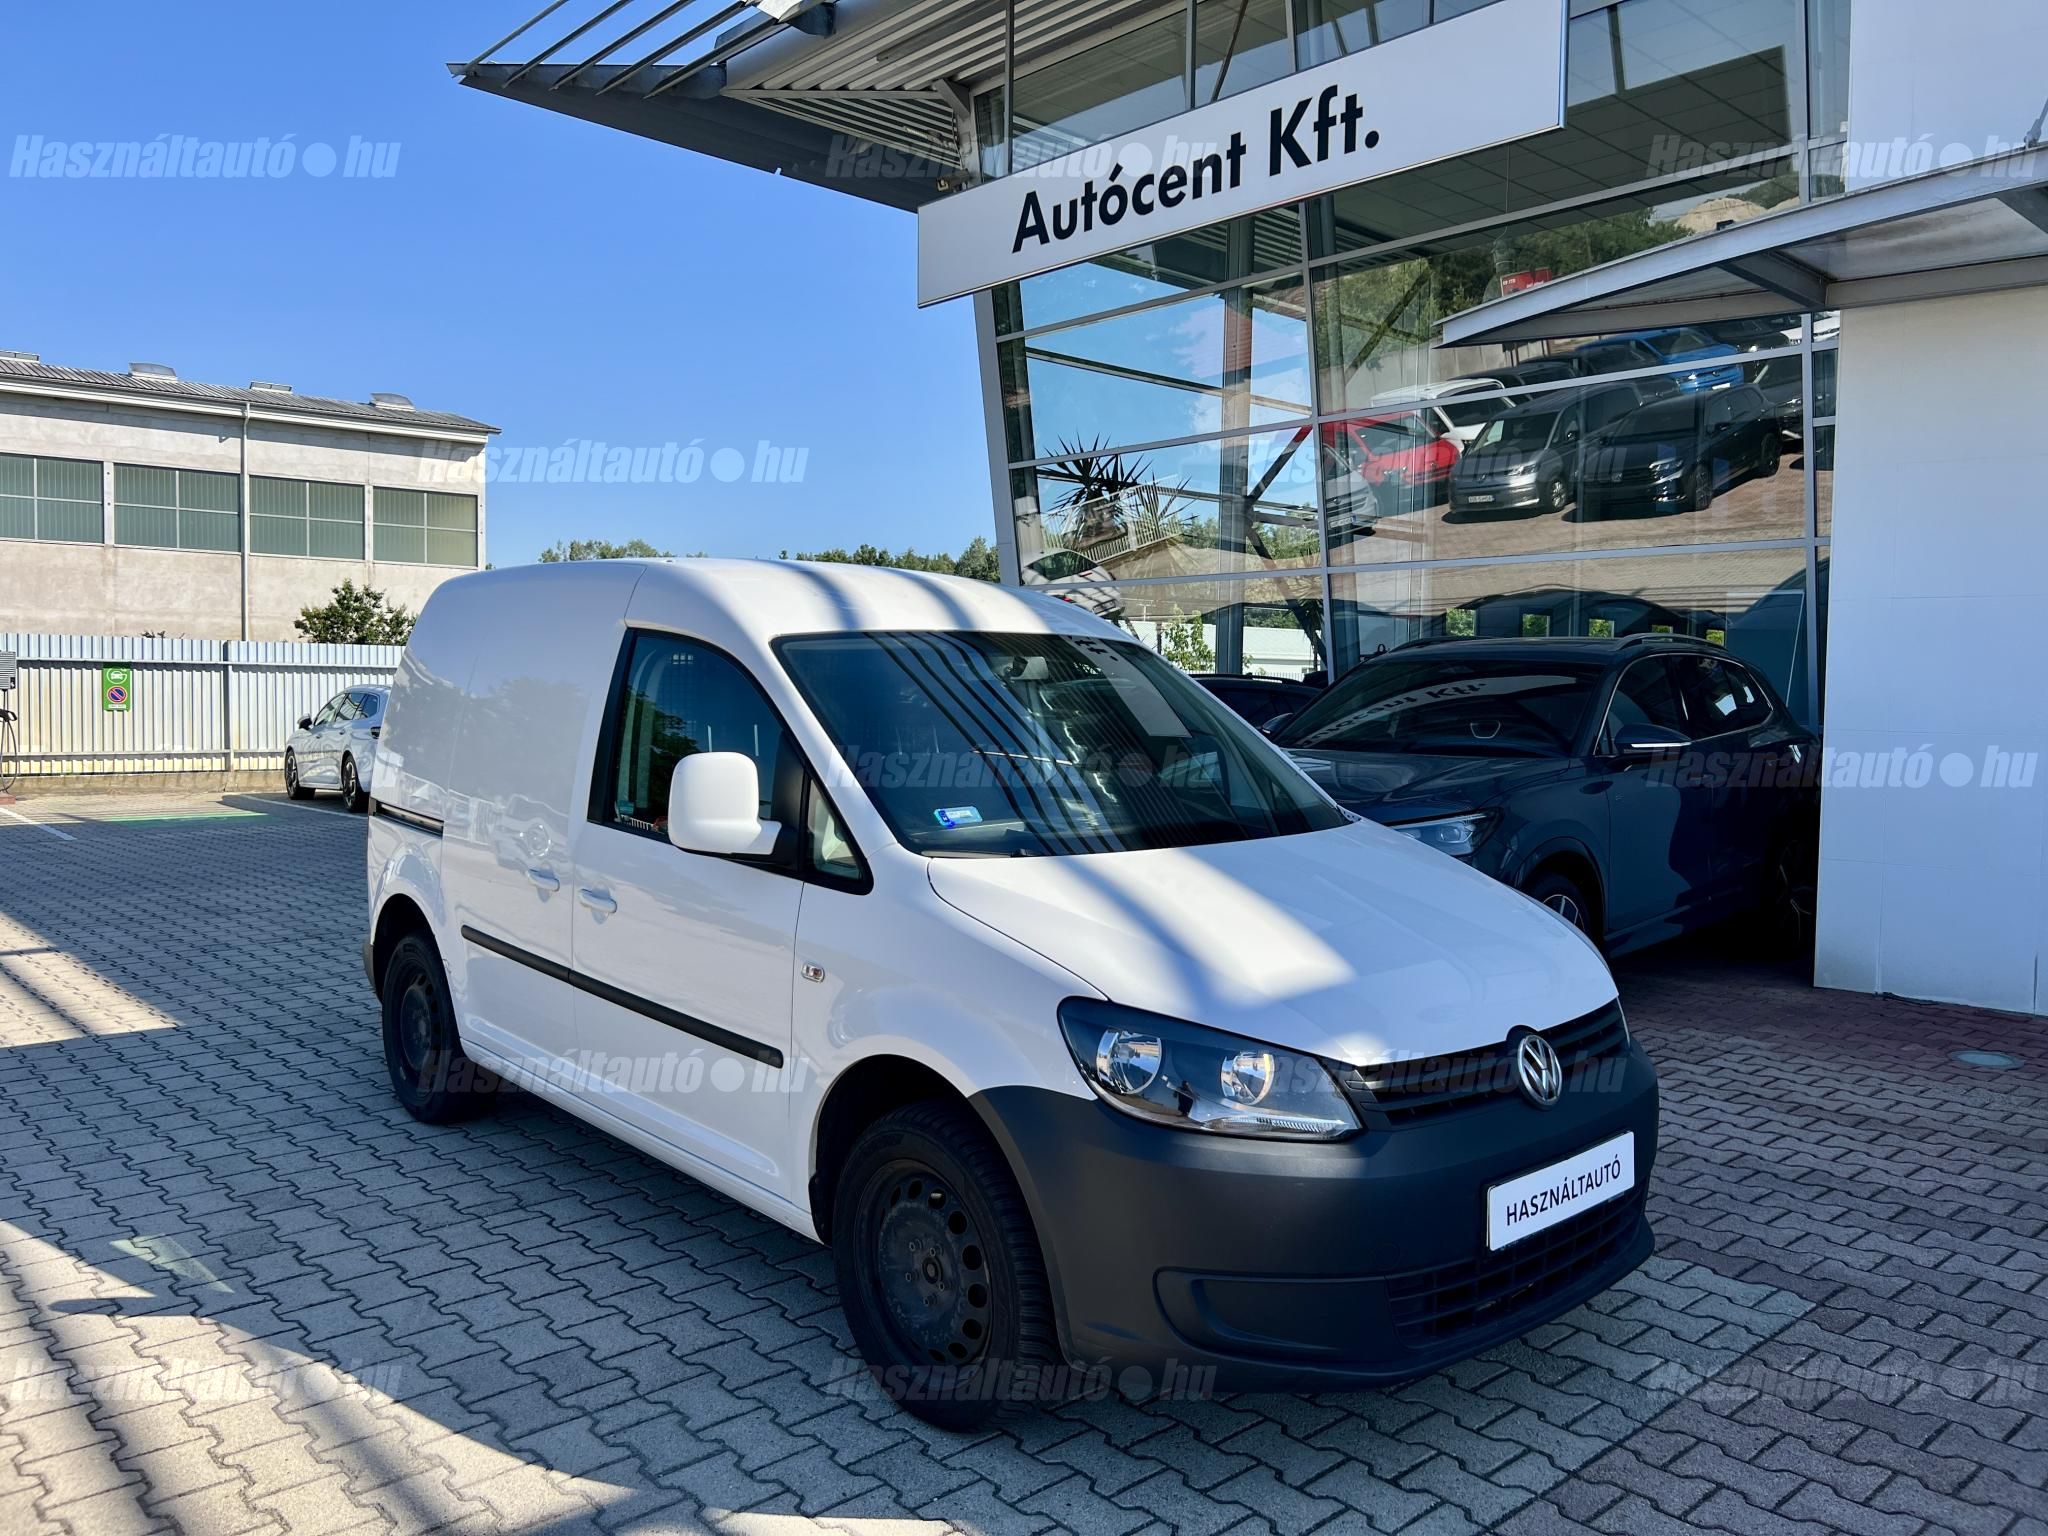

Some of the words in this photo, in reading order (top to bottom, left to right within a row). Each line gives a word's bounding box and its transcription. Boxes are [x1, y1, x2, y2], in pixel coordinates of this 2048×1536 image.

[1012, 132, 1247, 254] Autócent
[1269, 84, 1380, 177] Kft.
[1506, 1153, 1621, 1226] HASZNÁLTAUTÓ
